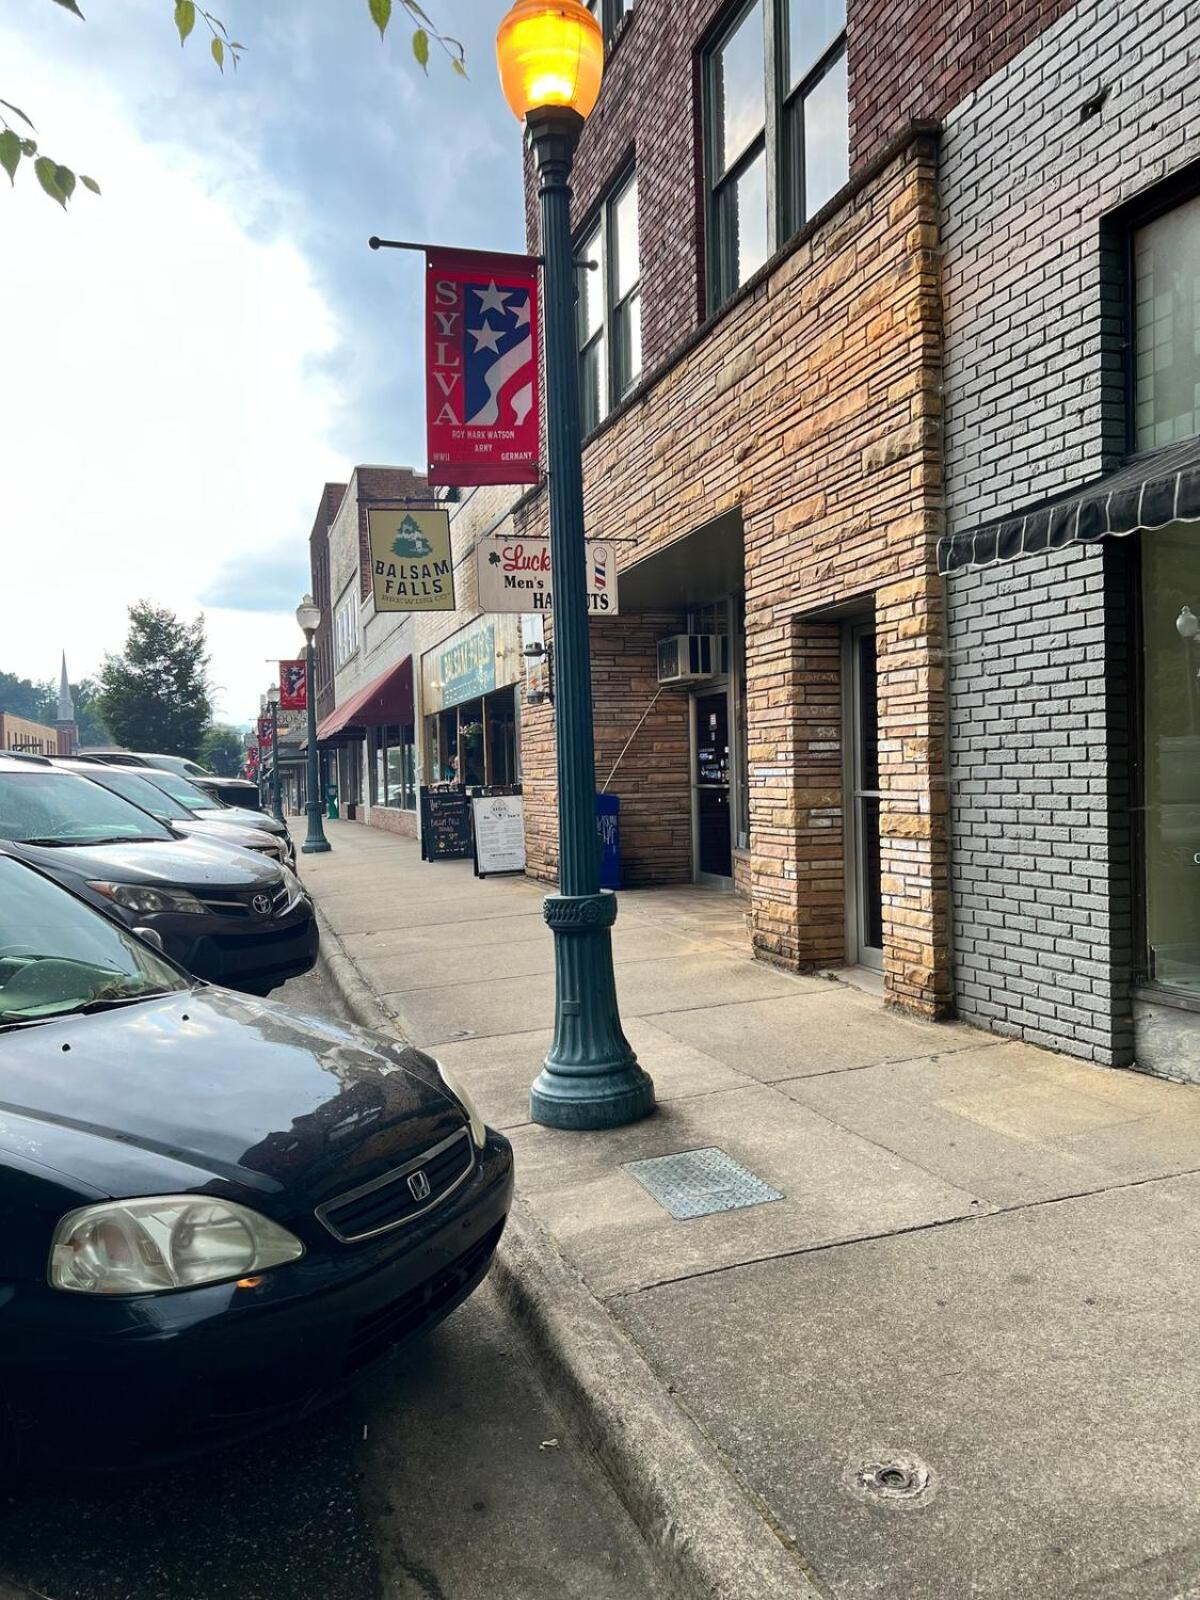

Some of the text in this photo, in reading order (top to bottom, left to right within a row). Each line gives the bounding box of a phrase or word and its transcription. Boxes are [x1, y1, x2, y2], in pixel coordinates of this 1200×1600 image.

[433, 280, 462, 426] SYLVA
[452, 430, 465, 439] ROY
[487, 430, 515, 439] WATSON
[474, 443, 493, 452] ARMY
[501, 451, 532, 461] GERMANY
[502, 544, 551, 572] Luck
[375, 560, 449, 579] BALSAM
[385, 579, 443, 596] FALLS
[504, 575, 544, 588] Men's
